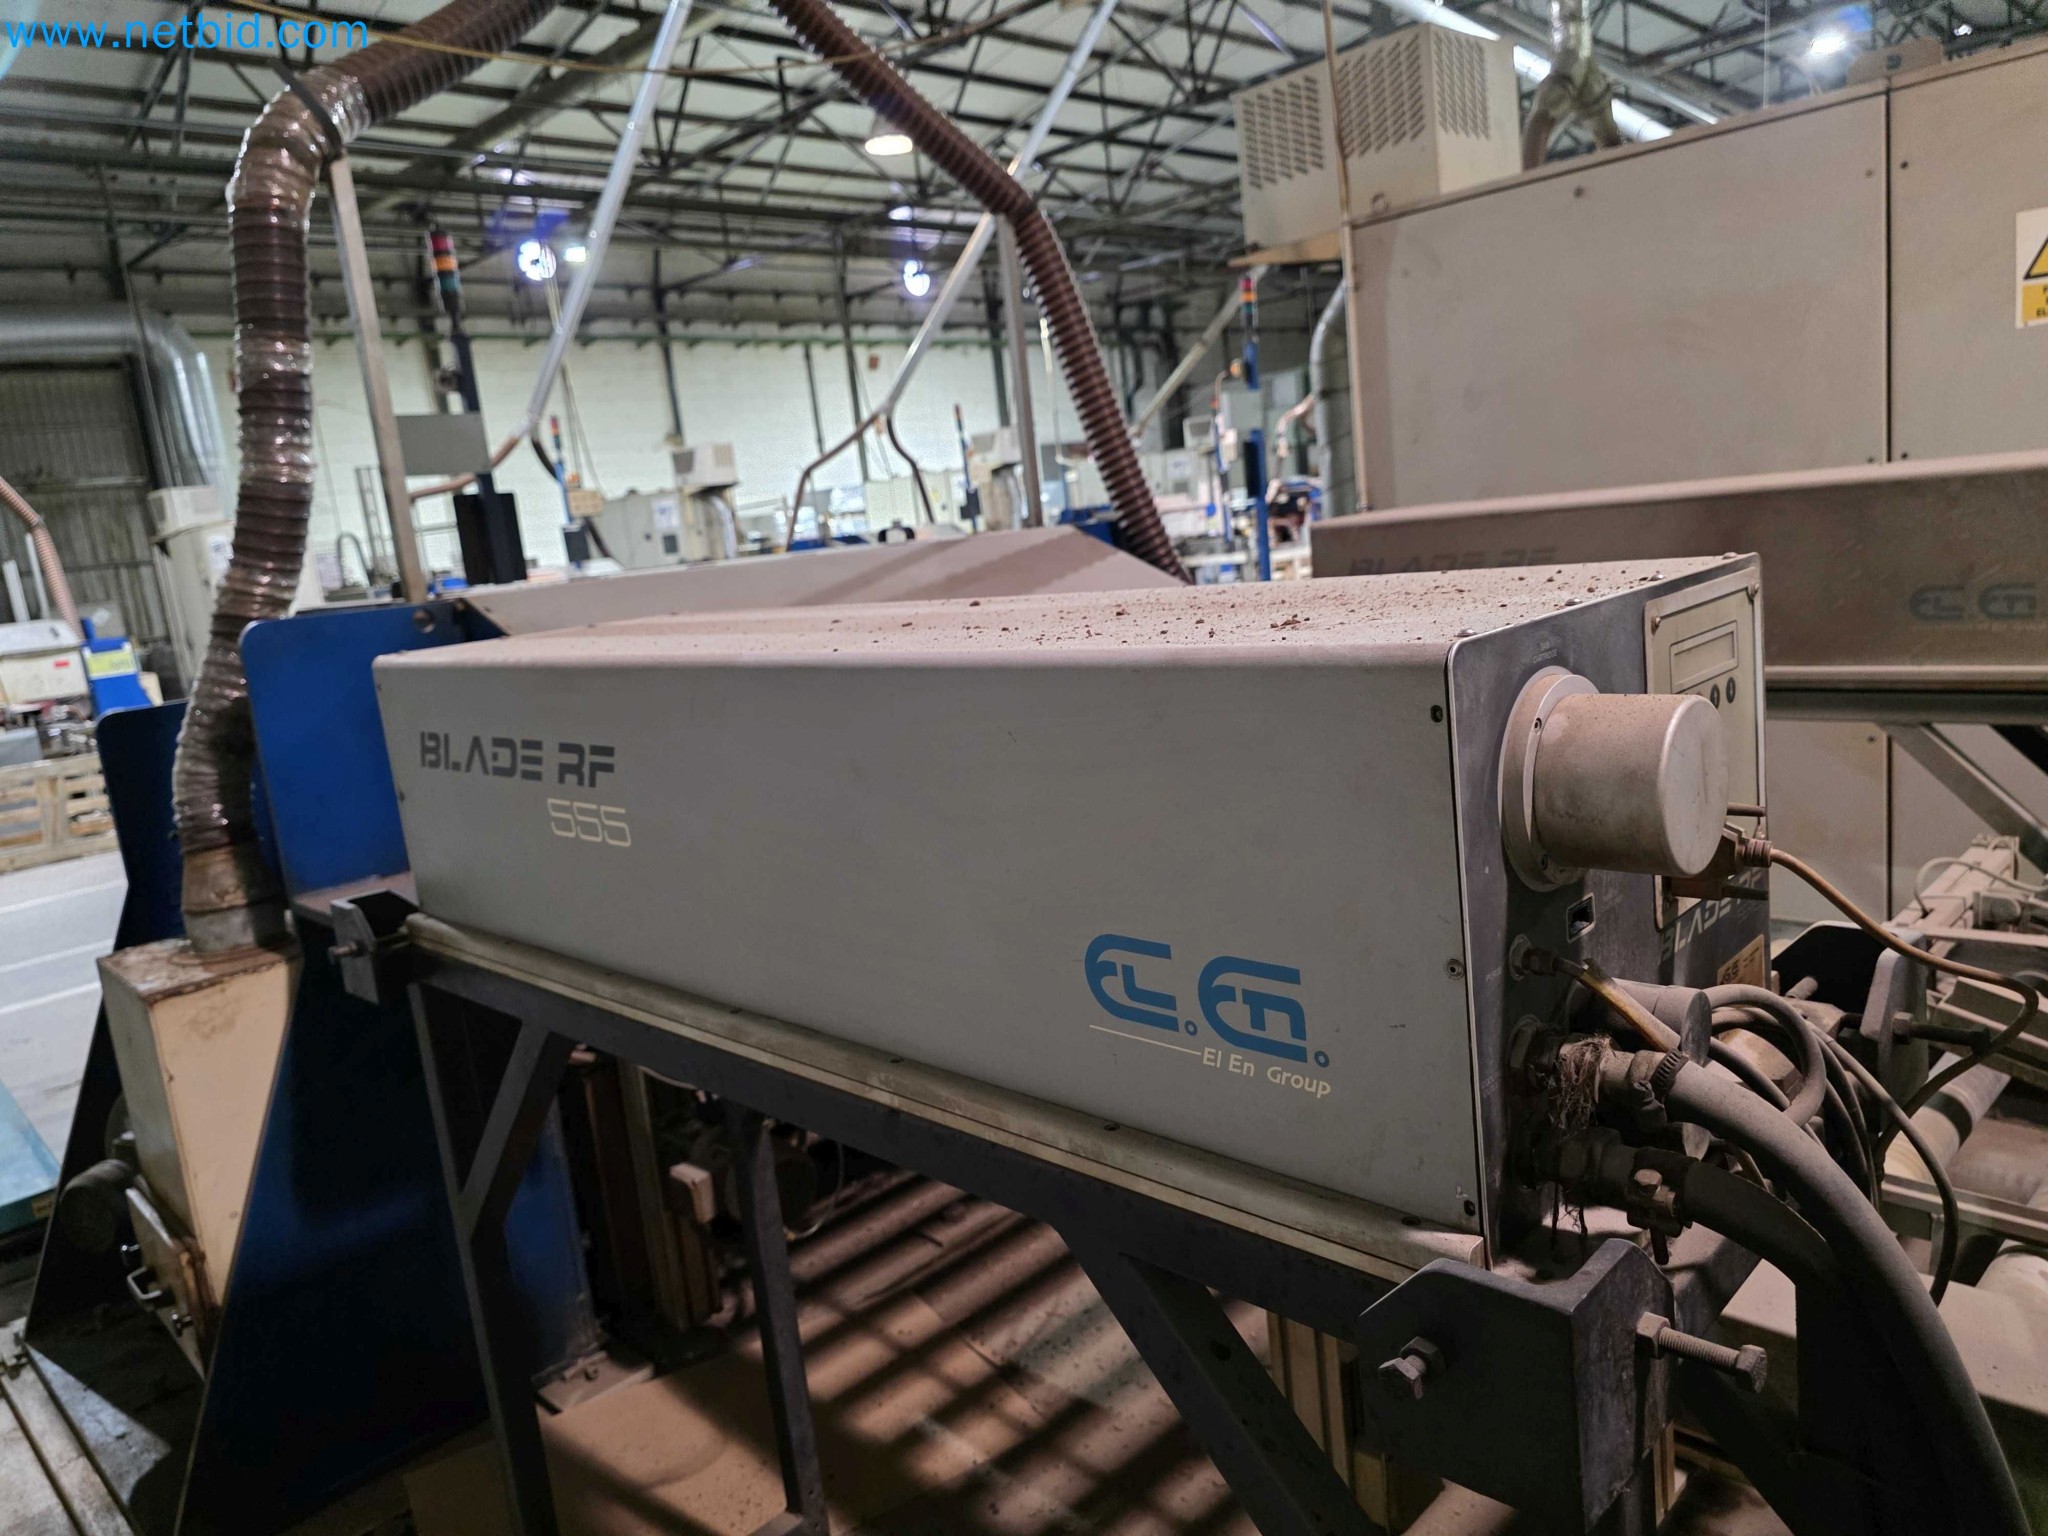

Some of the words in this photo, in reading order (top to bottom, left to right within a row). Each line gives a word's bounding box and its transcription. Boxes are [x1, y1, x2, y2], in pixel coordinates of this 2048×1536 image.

[420, 731, 544, 782] BLADE
[558, 742, 616, 789] RF
[547, 797, 632, 849] 555
[1203, 1046, 1222, 1068] El
[1228, 1053, 1255, 1077] En
[1266, 1066, 1332, 1099] Group
